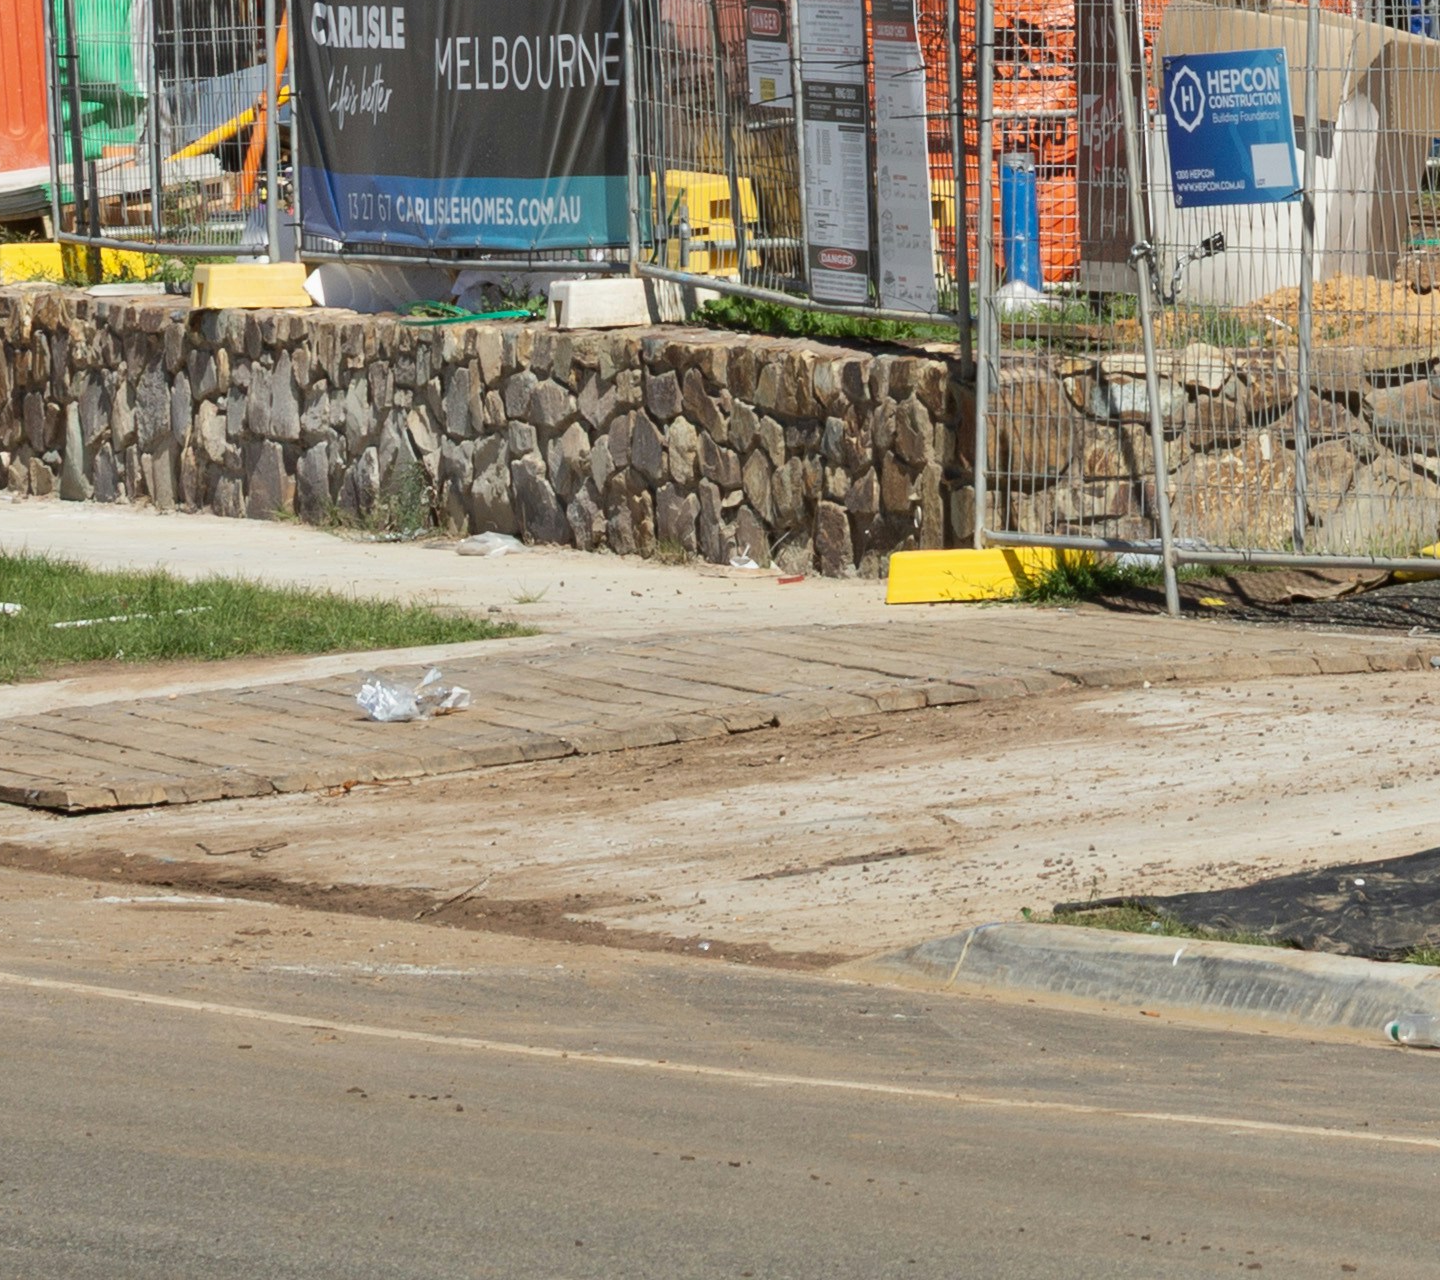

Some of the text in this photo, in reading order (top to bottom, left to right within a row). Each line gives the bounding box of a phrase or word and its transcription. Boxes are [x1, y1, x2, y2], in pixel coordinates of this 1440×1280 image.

[311, 2, 405, 50] CARLISLE
[434, 32, 620, 91] MELBOURNE
[360, 62, 393, 126] better
[1207, 66, 1280, 94] HEPCON
[1181, 85, 1195, 112] H
[1209, 92, 1281, 109] CONSTRUCTION
[1212, 111, 1281, 125] Building Foundations
[347, 193, 581, 226] 13 27 67 CARLISLEHOMES.COM.AU
[820, 253, 854, 267] DANGER
